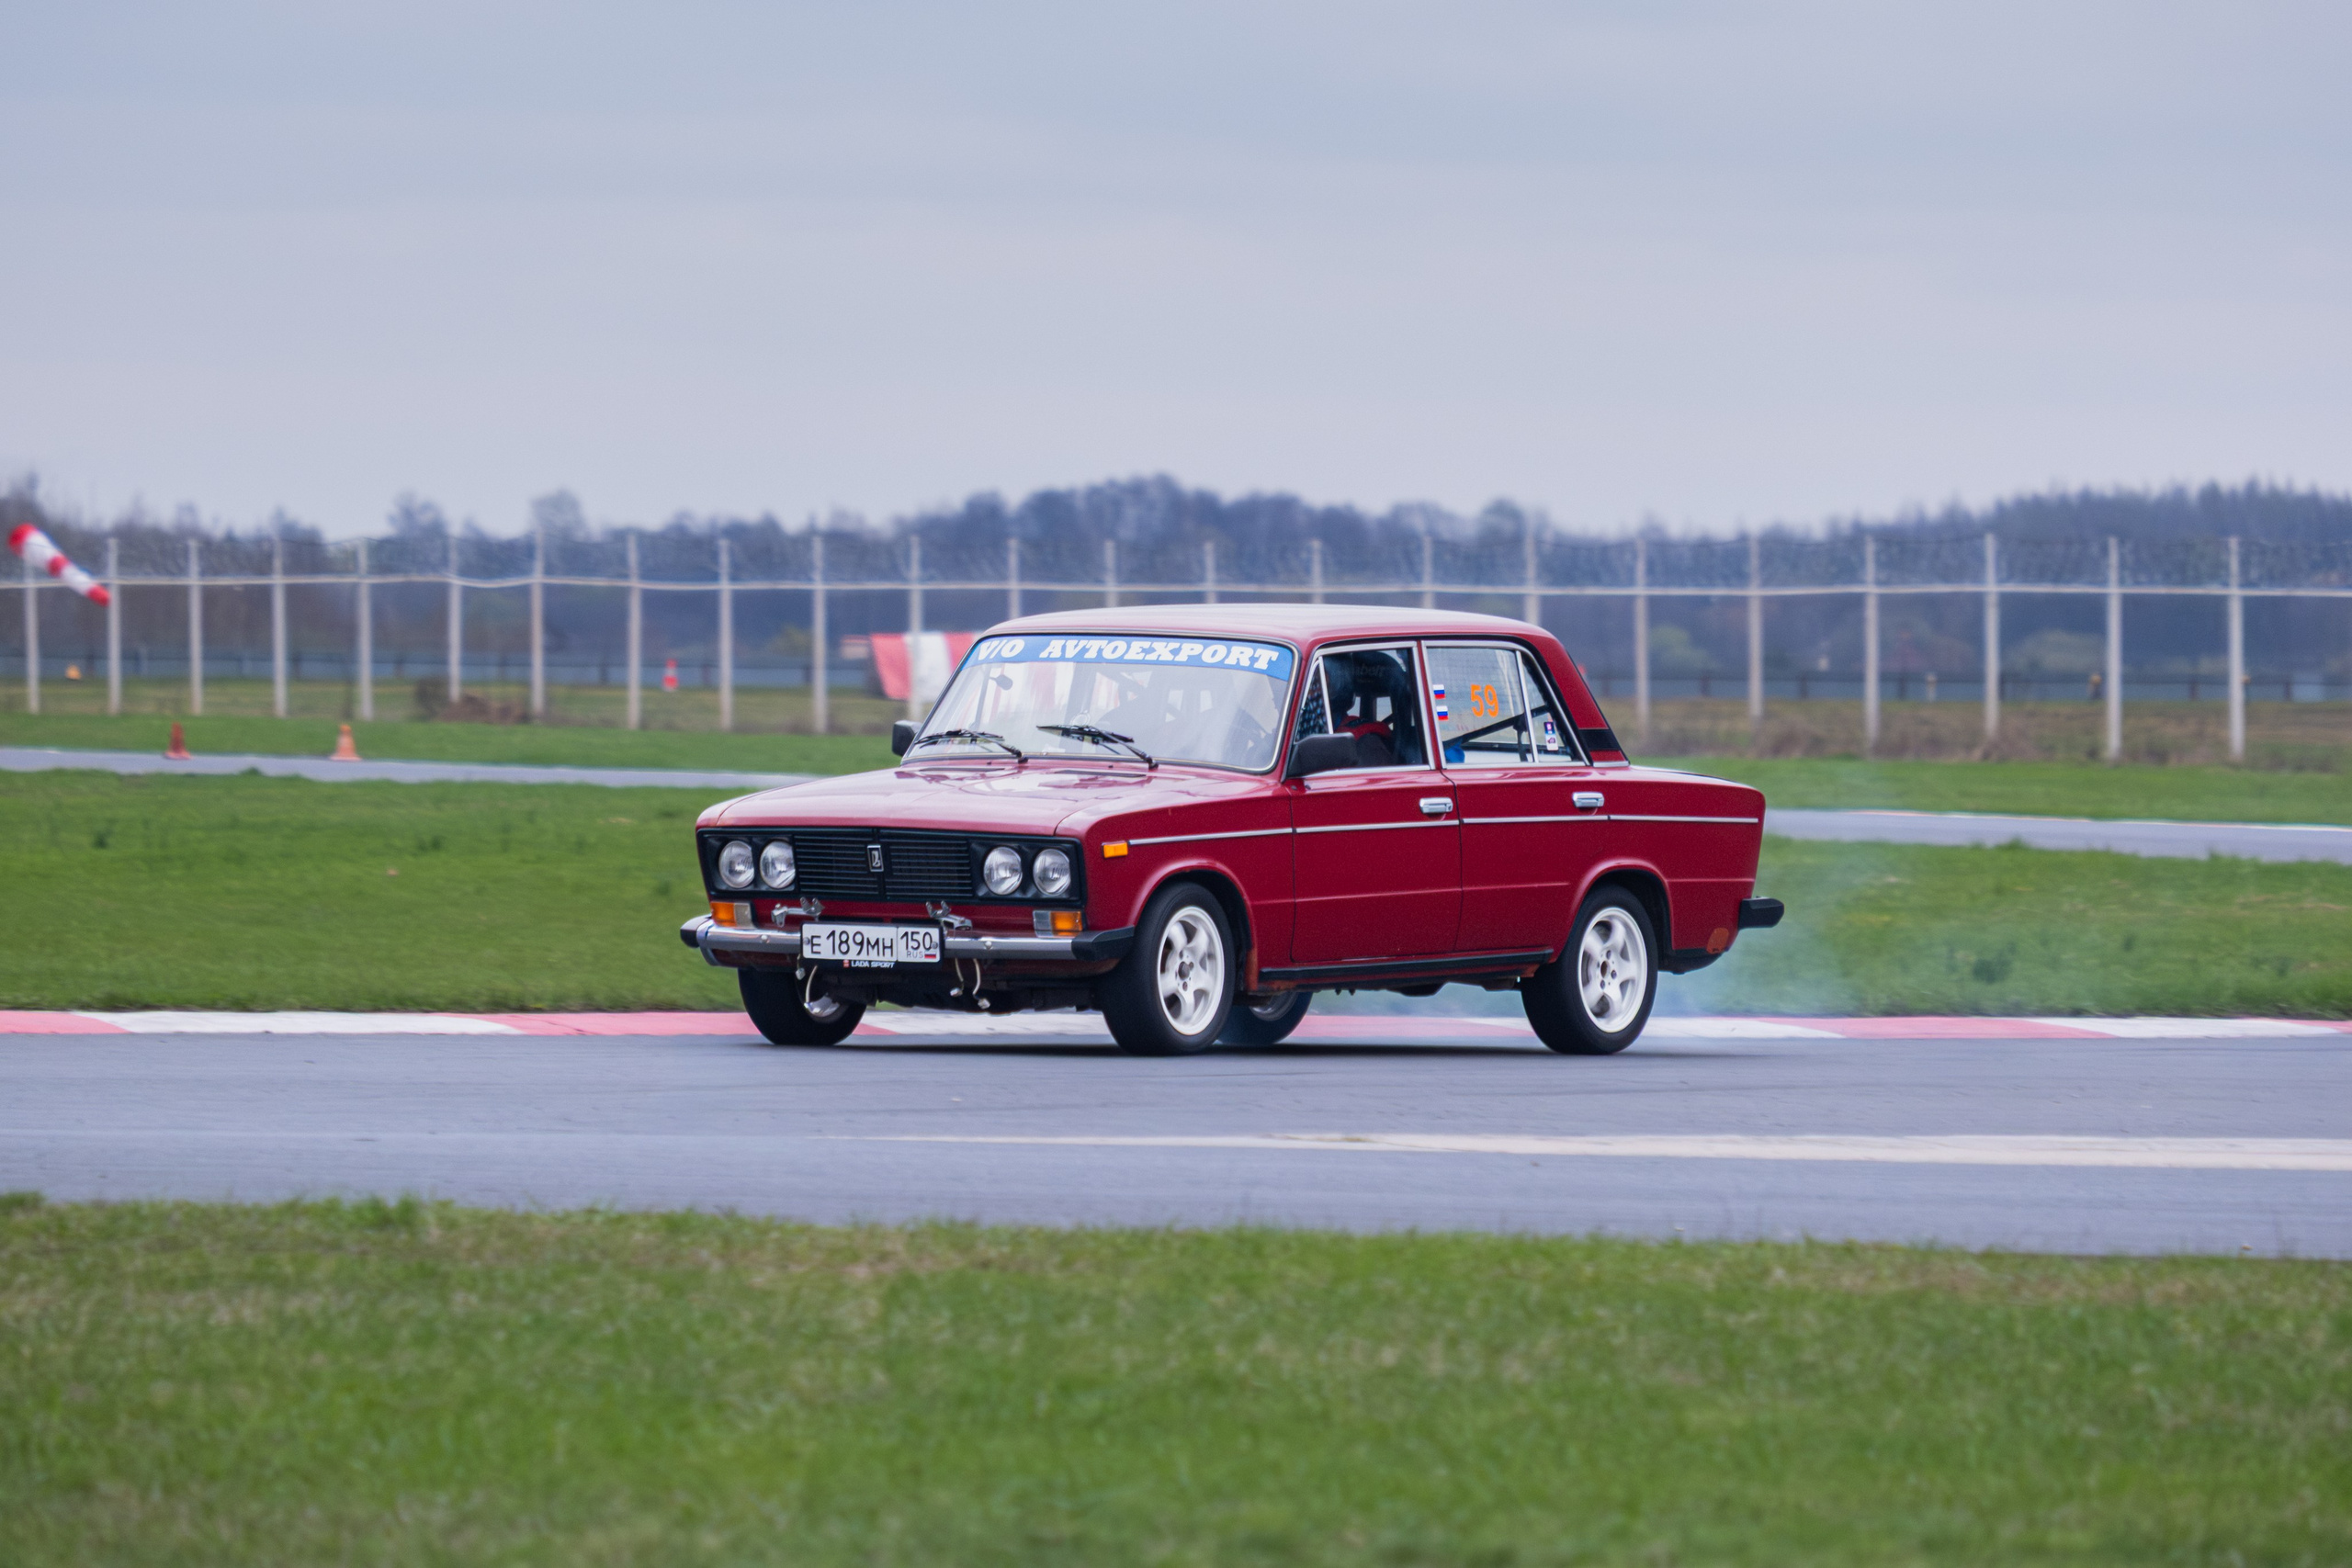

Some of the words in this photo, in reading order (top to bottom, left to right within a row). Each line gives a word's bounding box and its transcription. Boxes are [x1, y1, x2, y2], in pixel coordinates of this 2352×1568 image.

[978, 638, 1025, 660] V/O
[1039, 639, 1280, 671] AVTOEXPORT
[1470, 683, 1499, 718] 59
[899, 931, 933, 951] 150
[851, 959, 870, 967] LADA
[906, 950, 924, 958] RUS
